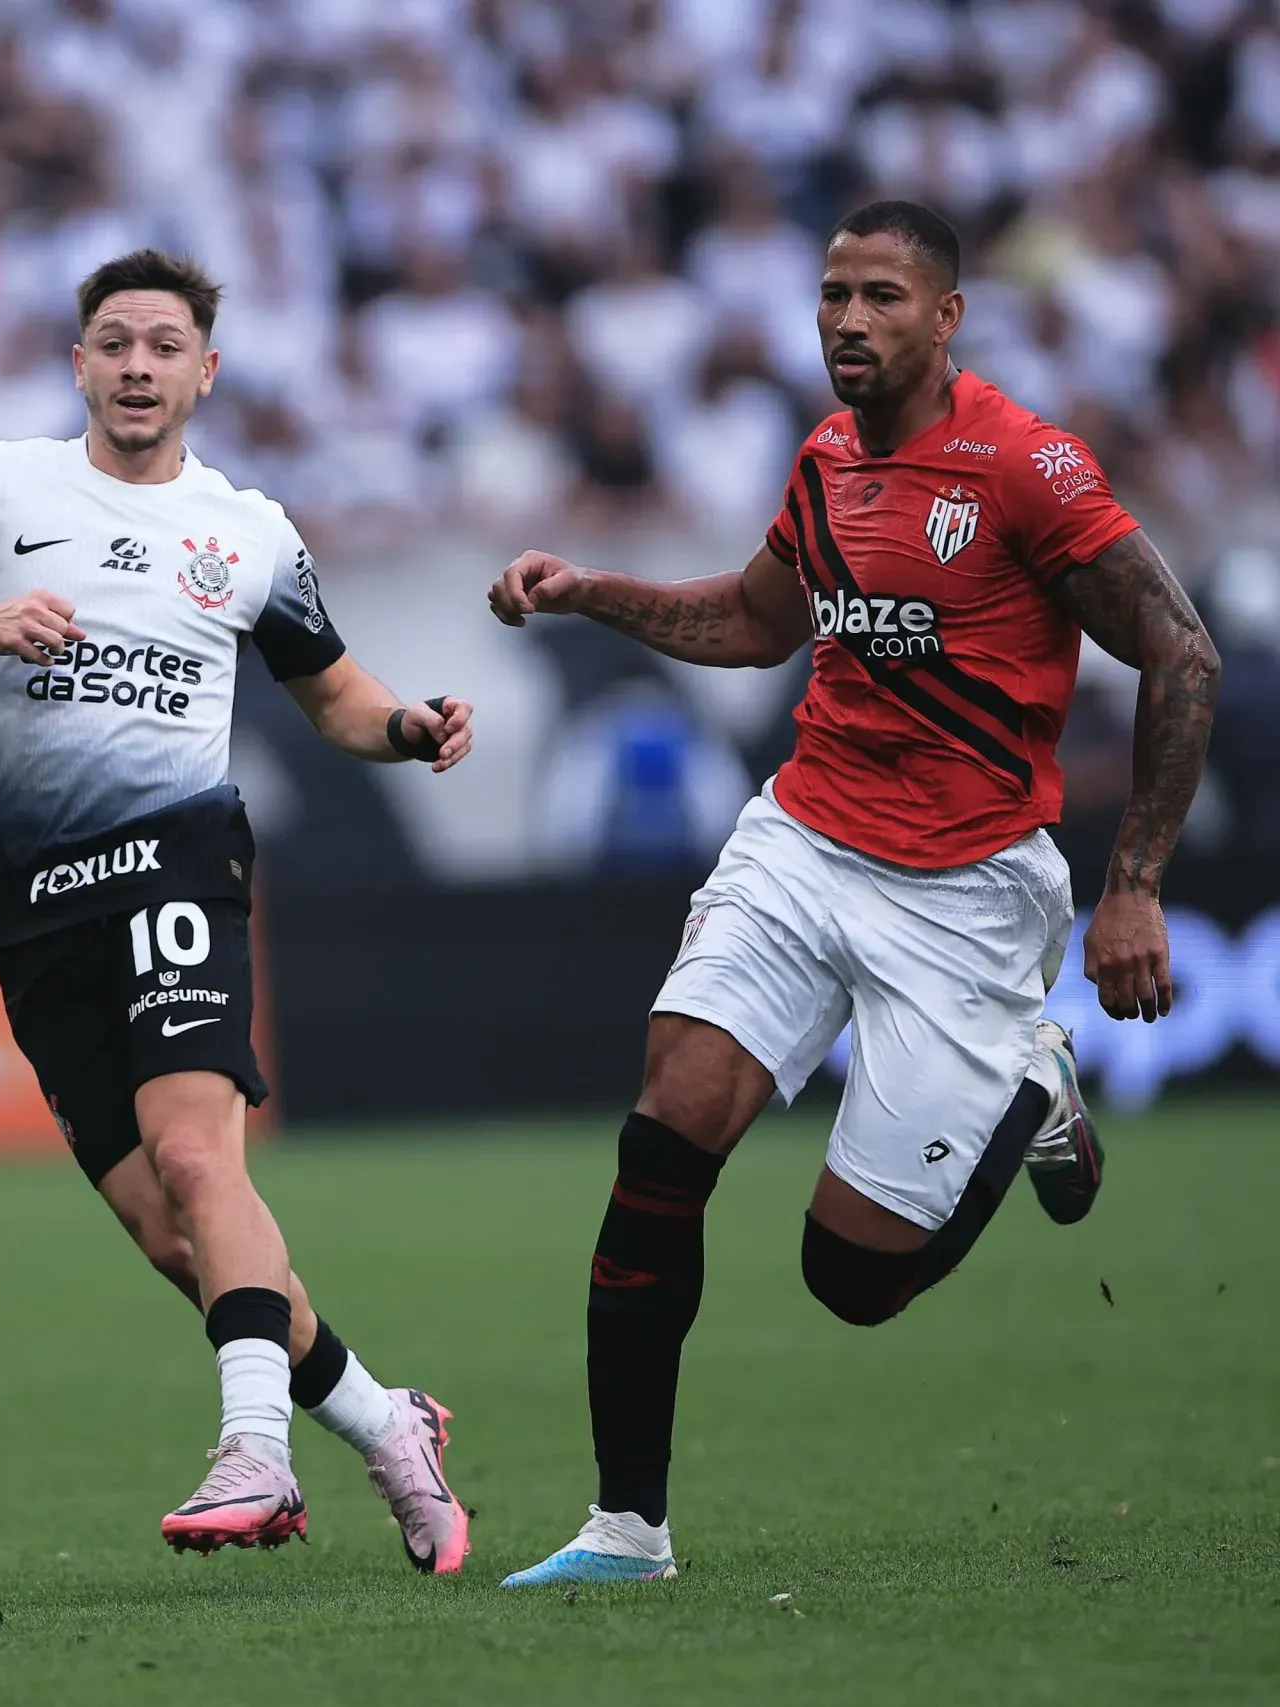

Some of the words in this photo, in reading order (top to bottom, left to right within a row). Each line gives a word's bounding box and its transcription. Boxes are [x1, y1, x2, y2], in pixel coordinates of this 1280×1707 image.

[959, 440, 997, 455] blaze
[99, 559, 151, 573] ALE
[813, 589, 934, 636] blaze
[866, 635, 939, 657] .com
[29, 839, 163, 904] FOXLUX
[129, 901, 211, 977] 10
[128, 988, 230, 1023] UniCesumar
